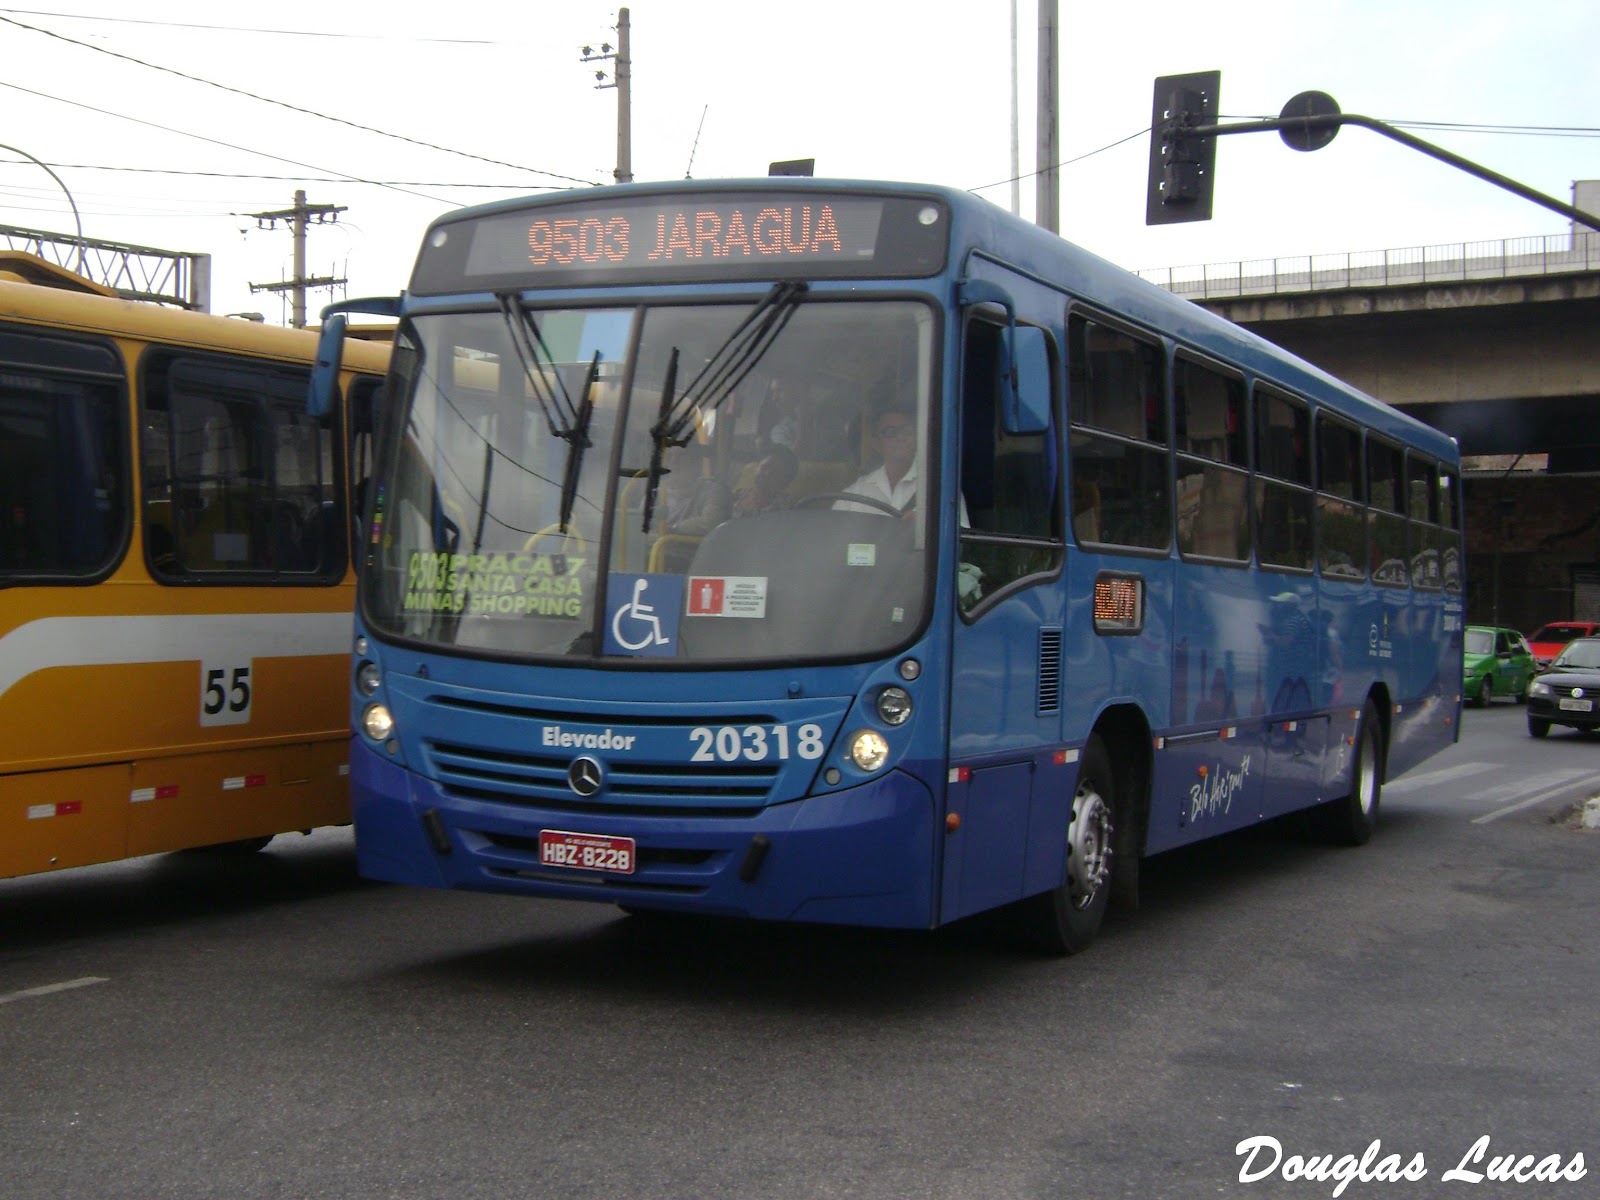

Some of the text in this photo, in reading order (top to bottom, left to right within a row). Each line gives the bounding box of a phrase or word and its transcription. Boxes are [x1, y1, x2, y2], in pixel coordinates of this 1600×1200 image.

[528, 205, 841, 265] 9503 JARAGUA
[408, 552, 449, 590] 9503
[566, 557, 587, 576] 7
[446, 573, 583, 596] SANTA CASA
[404, 591, 582, 617] MINAS SHOPPING
[204, 667, 250, 715] 55
[542, 726, 636, 751] Elevador
[689, 723, 825, 762] 20318
